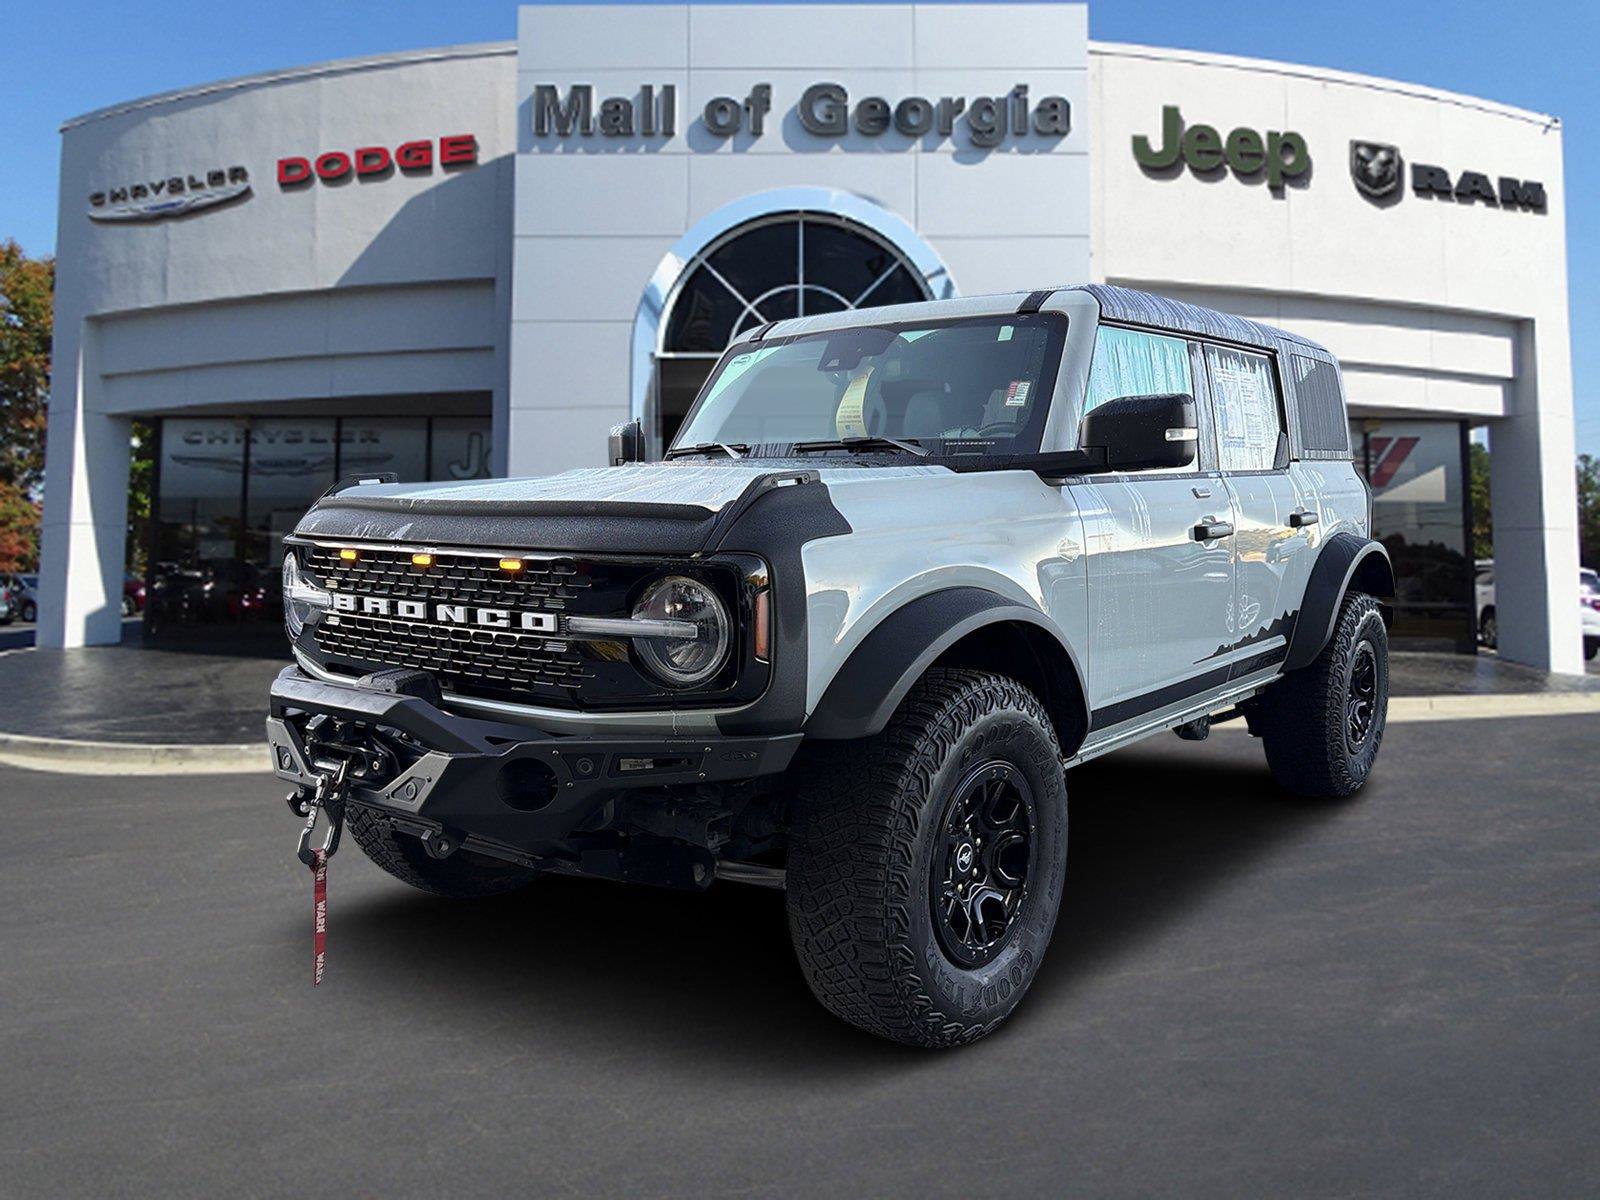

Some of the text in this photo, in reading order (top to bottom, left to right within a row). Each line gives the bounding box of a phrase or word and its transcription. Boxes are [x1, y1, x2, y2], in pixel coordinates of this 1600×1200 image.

[533, 83, 1072, 148] Mall of Georgia
[277, 134, 477, 188] DODGE
[1131, 104, 1310, 193] Jeep
[89, 165, 249, 207] CHRYSLER
[1411, 162, 1547, 213] RAM
[333, 592, 557, 632] BRONCO
[316, 899, 326, 934] WARN
